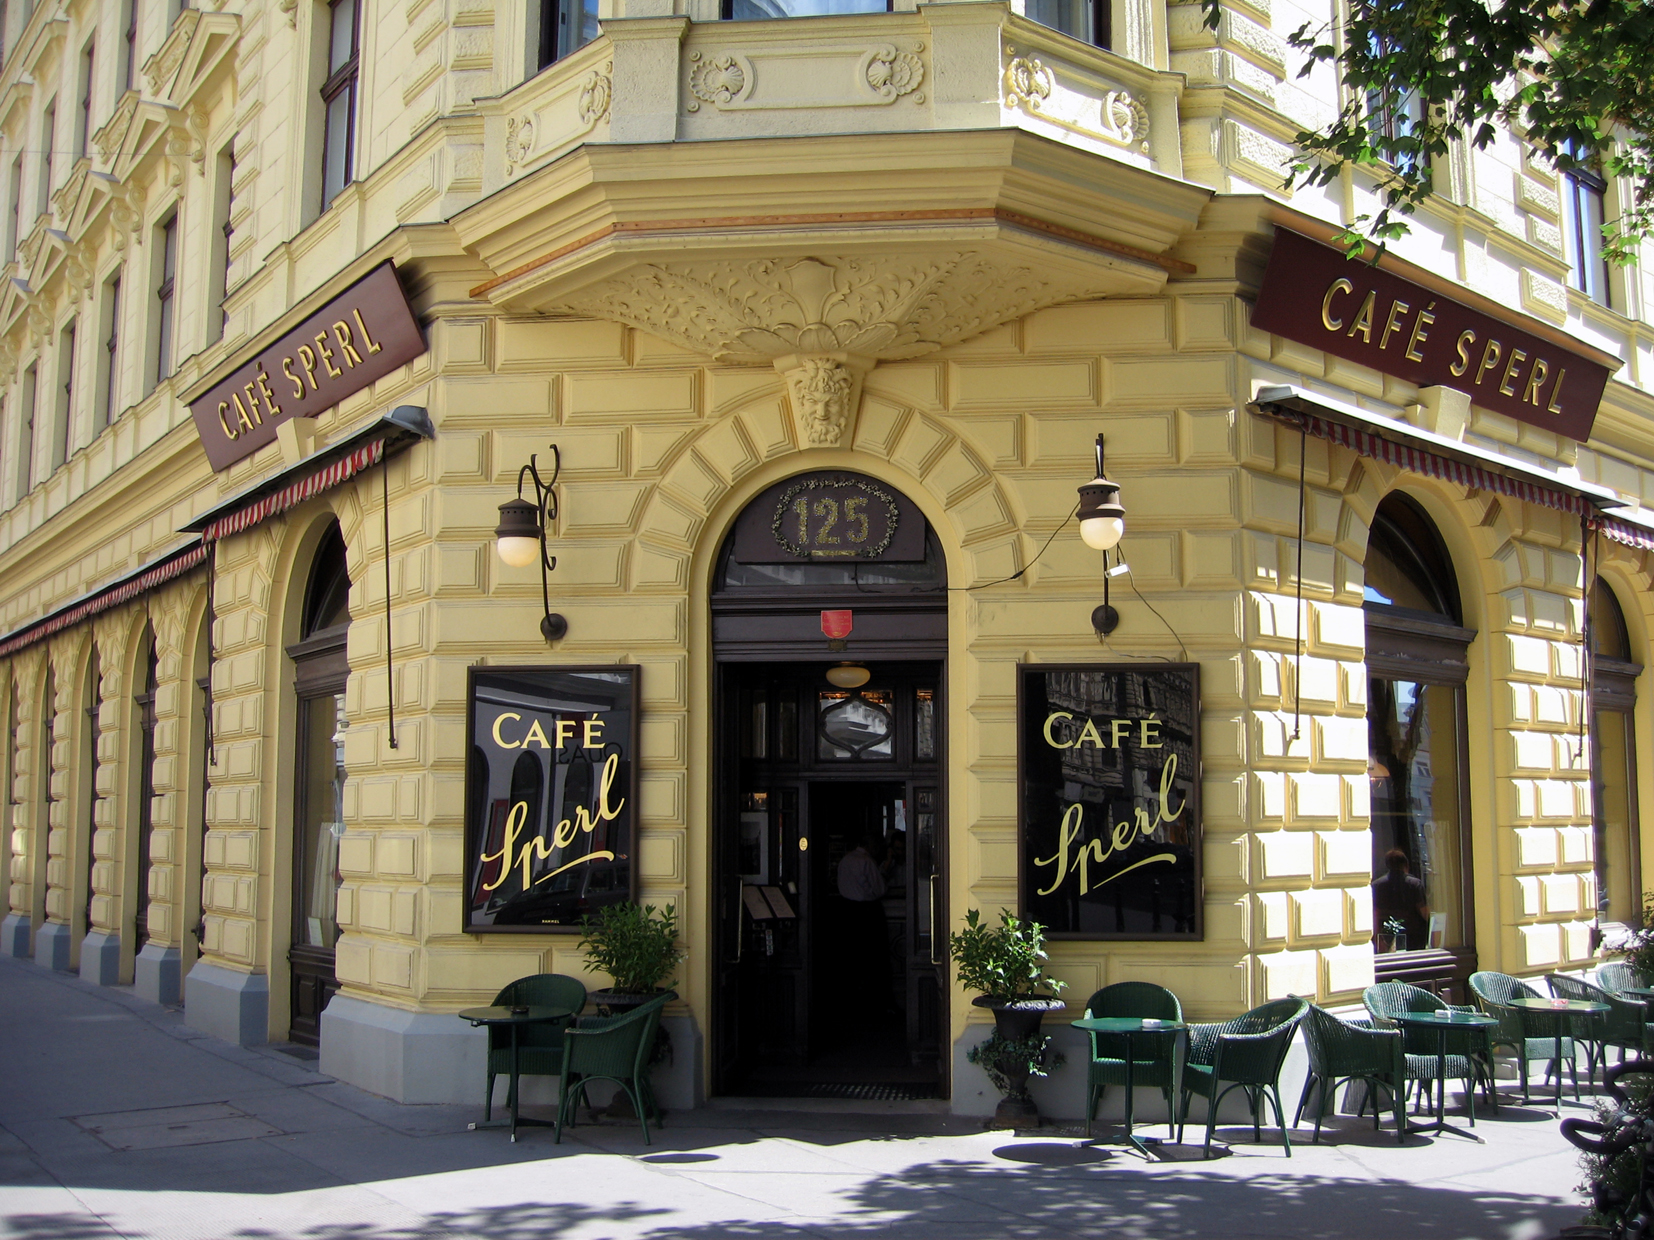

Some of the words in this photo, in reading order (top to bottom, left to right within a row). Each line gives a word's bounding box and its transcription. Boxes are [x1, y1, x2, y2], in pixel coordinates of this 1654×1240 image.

[218, 362, 281, 441] CAFÉ
[282, 308, 382, 400] SPERL
[1321, 277, 1437, 363] CAFÉ
[1449, 329, 1567, 415] SPERL
[793, 496, 869, 544] 125
[492, 712, 606, 749] CAFÉ
[1043, 711, 1164, 749] CAFÉ
[480, 753, 625, 891] Sperl
[1034, 753, 1186, 896] Sperl
